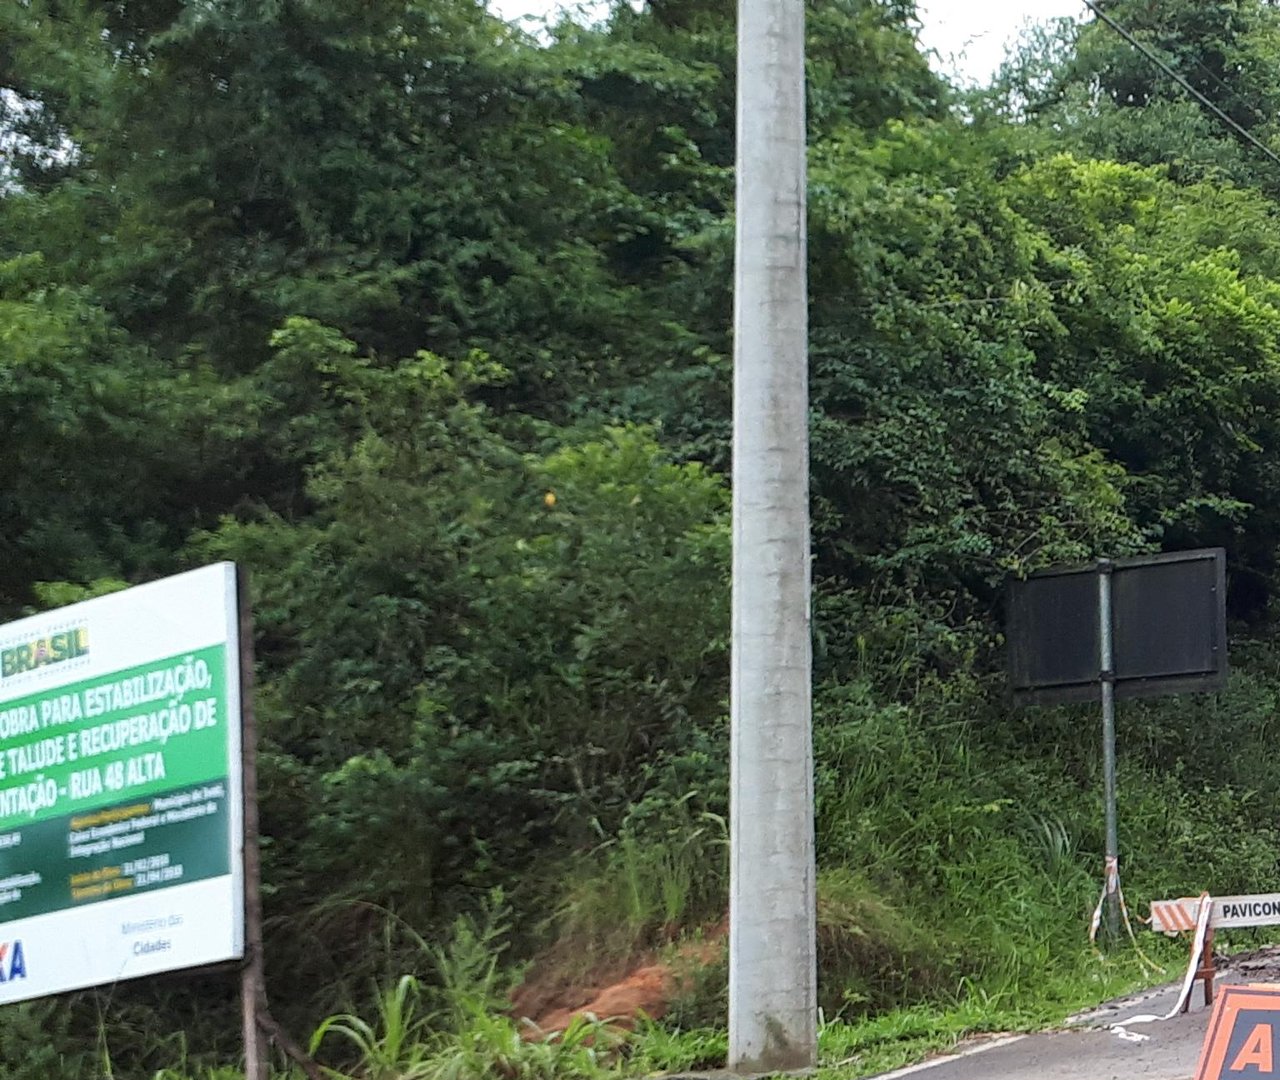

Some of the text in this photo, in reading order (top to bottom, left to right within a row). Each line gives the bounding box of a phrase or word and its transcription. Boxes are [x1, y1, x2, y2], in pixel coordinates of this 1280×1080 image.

[1, 628, 89, 678] BRASIL
[0, 704, 39, 739] OBRA
[41, 693, 83, 727] PARA
[7, 736, 66, 775] TALUDE
[68, 733, 78, 761] E
[80, 699, 192, 757] RECUPERAÇÃO
[193, 697, 217, 730] DE
[71, 767, 103, 800] RUA
[104, 760, 125, 790] 48
[126, 752, 166, 786] ALTA
